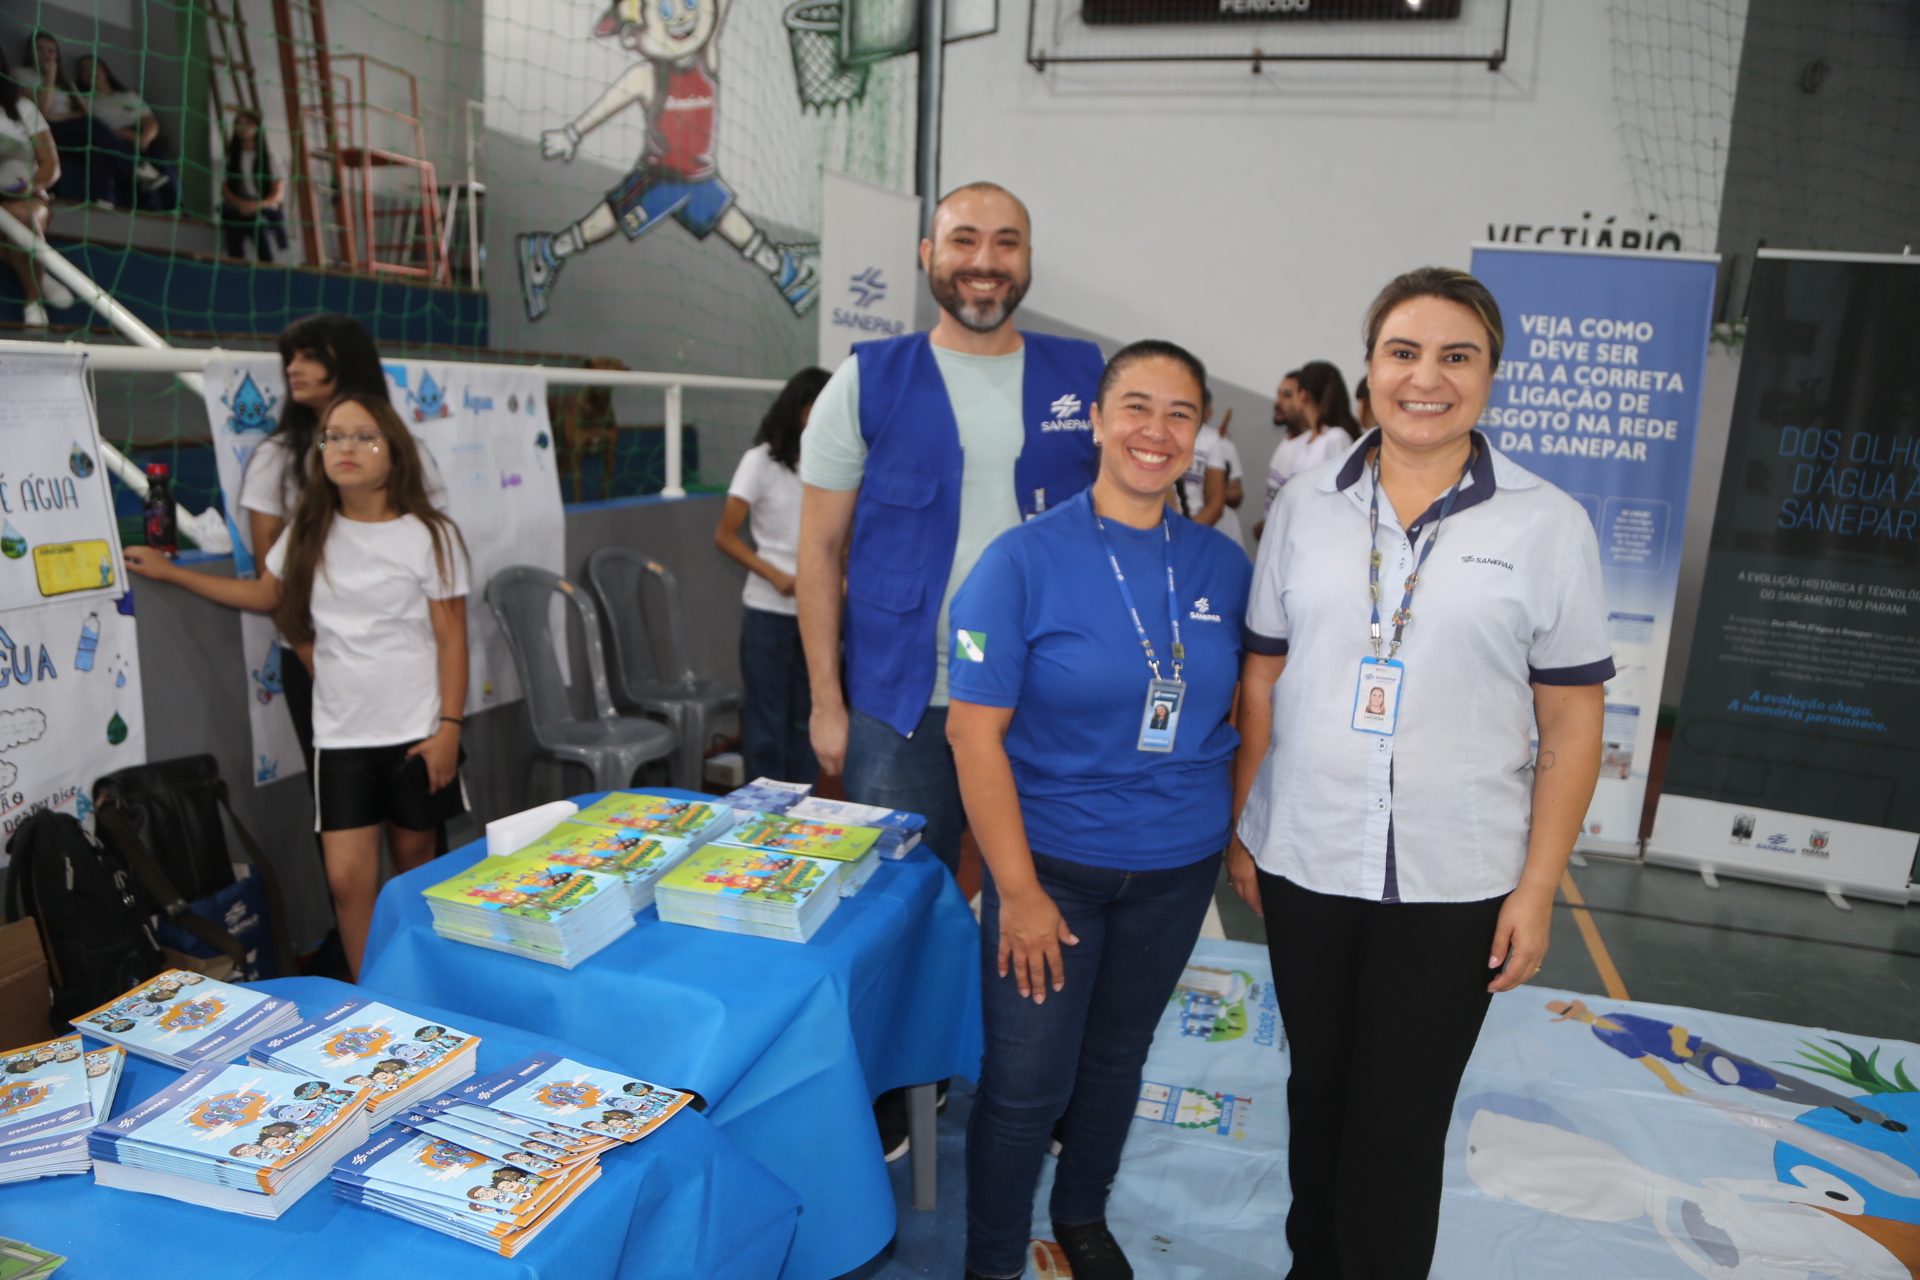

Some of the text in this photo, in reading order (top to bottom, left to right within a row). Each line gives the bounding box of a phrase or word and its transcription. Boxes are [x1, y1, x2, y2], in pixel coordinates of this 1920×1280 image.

[1520, 314, 1654, 342] VEJA COMO
[1530, 338, 1639, 365] DEVE SER
[1493, 360, 1684, 394] EITA A CORRETA
[1508, 384, 1650, 414] LIGAÇÃO DE
[1576, 413, 1612, 435] NA
[1618, 416, 1678, 440] REDE
[1501, 431, 1648, 462] DA SANEPAR
[1779, 425, 1842, 460] DOS
[20, 472, 79, 512] ÁGUA
[1778, 498, 1918, 540] SANEPAR
[1476, 557, 1514, 571] SANEPAR
[1737, 571, 1746, 581] A
[1801, 577, 1856, 593] HISTÓRICA
[1777, 590, 1846, 608] SANEAMENTO
[1848, 599, 1863, 611] NO
[1727, 699, 1888, 731] A memória permanece.
[1749, 690, 1874, 718] A evolução chega.
[283, 1023, 316, 1041] SANEPAR
[490, 1078, 515, 1094] SANEPAR
[135, 1097, 170, 1119] SANEPAR
[8, 1118, 57, 1135] SANEPAR
[10, 1142, 59, 1156] SANEPAR
[366, 1137, 396, 1156] SANEPAR
